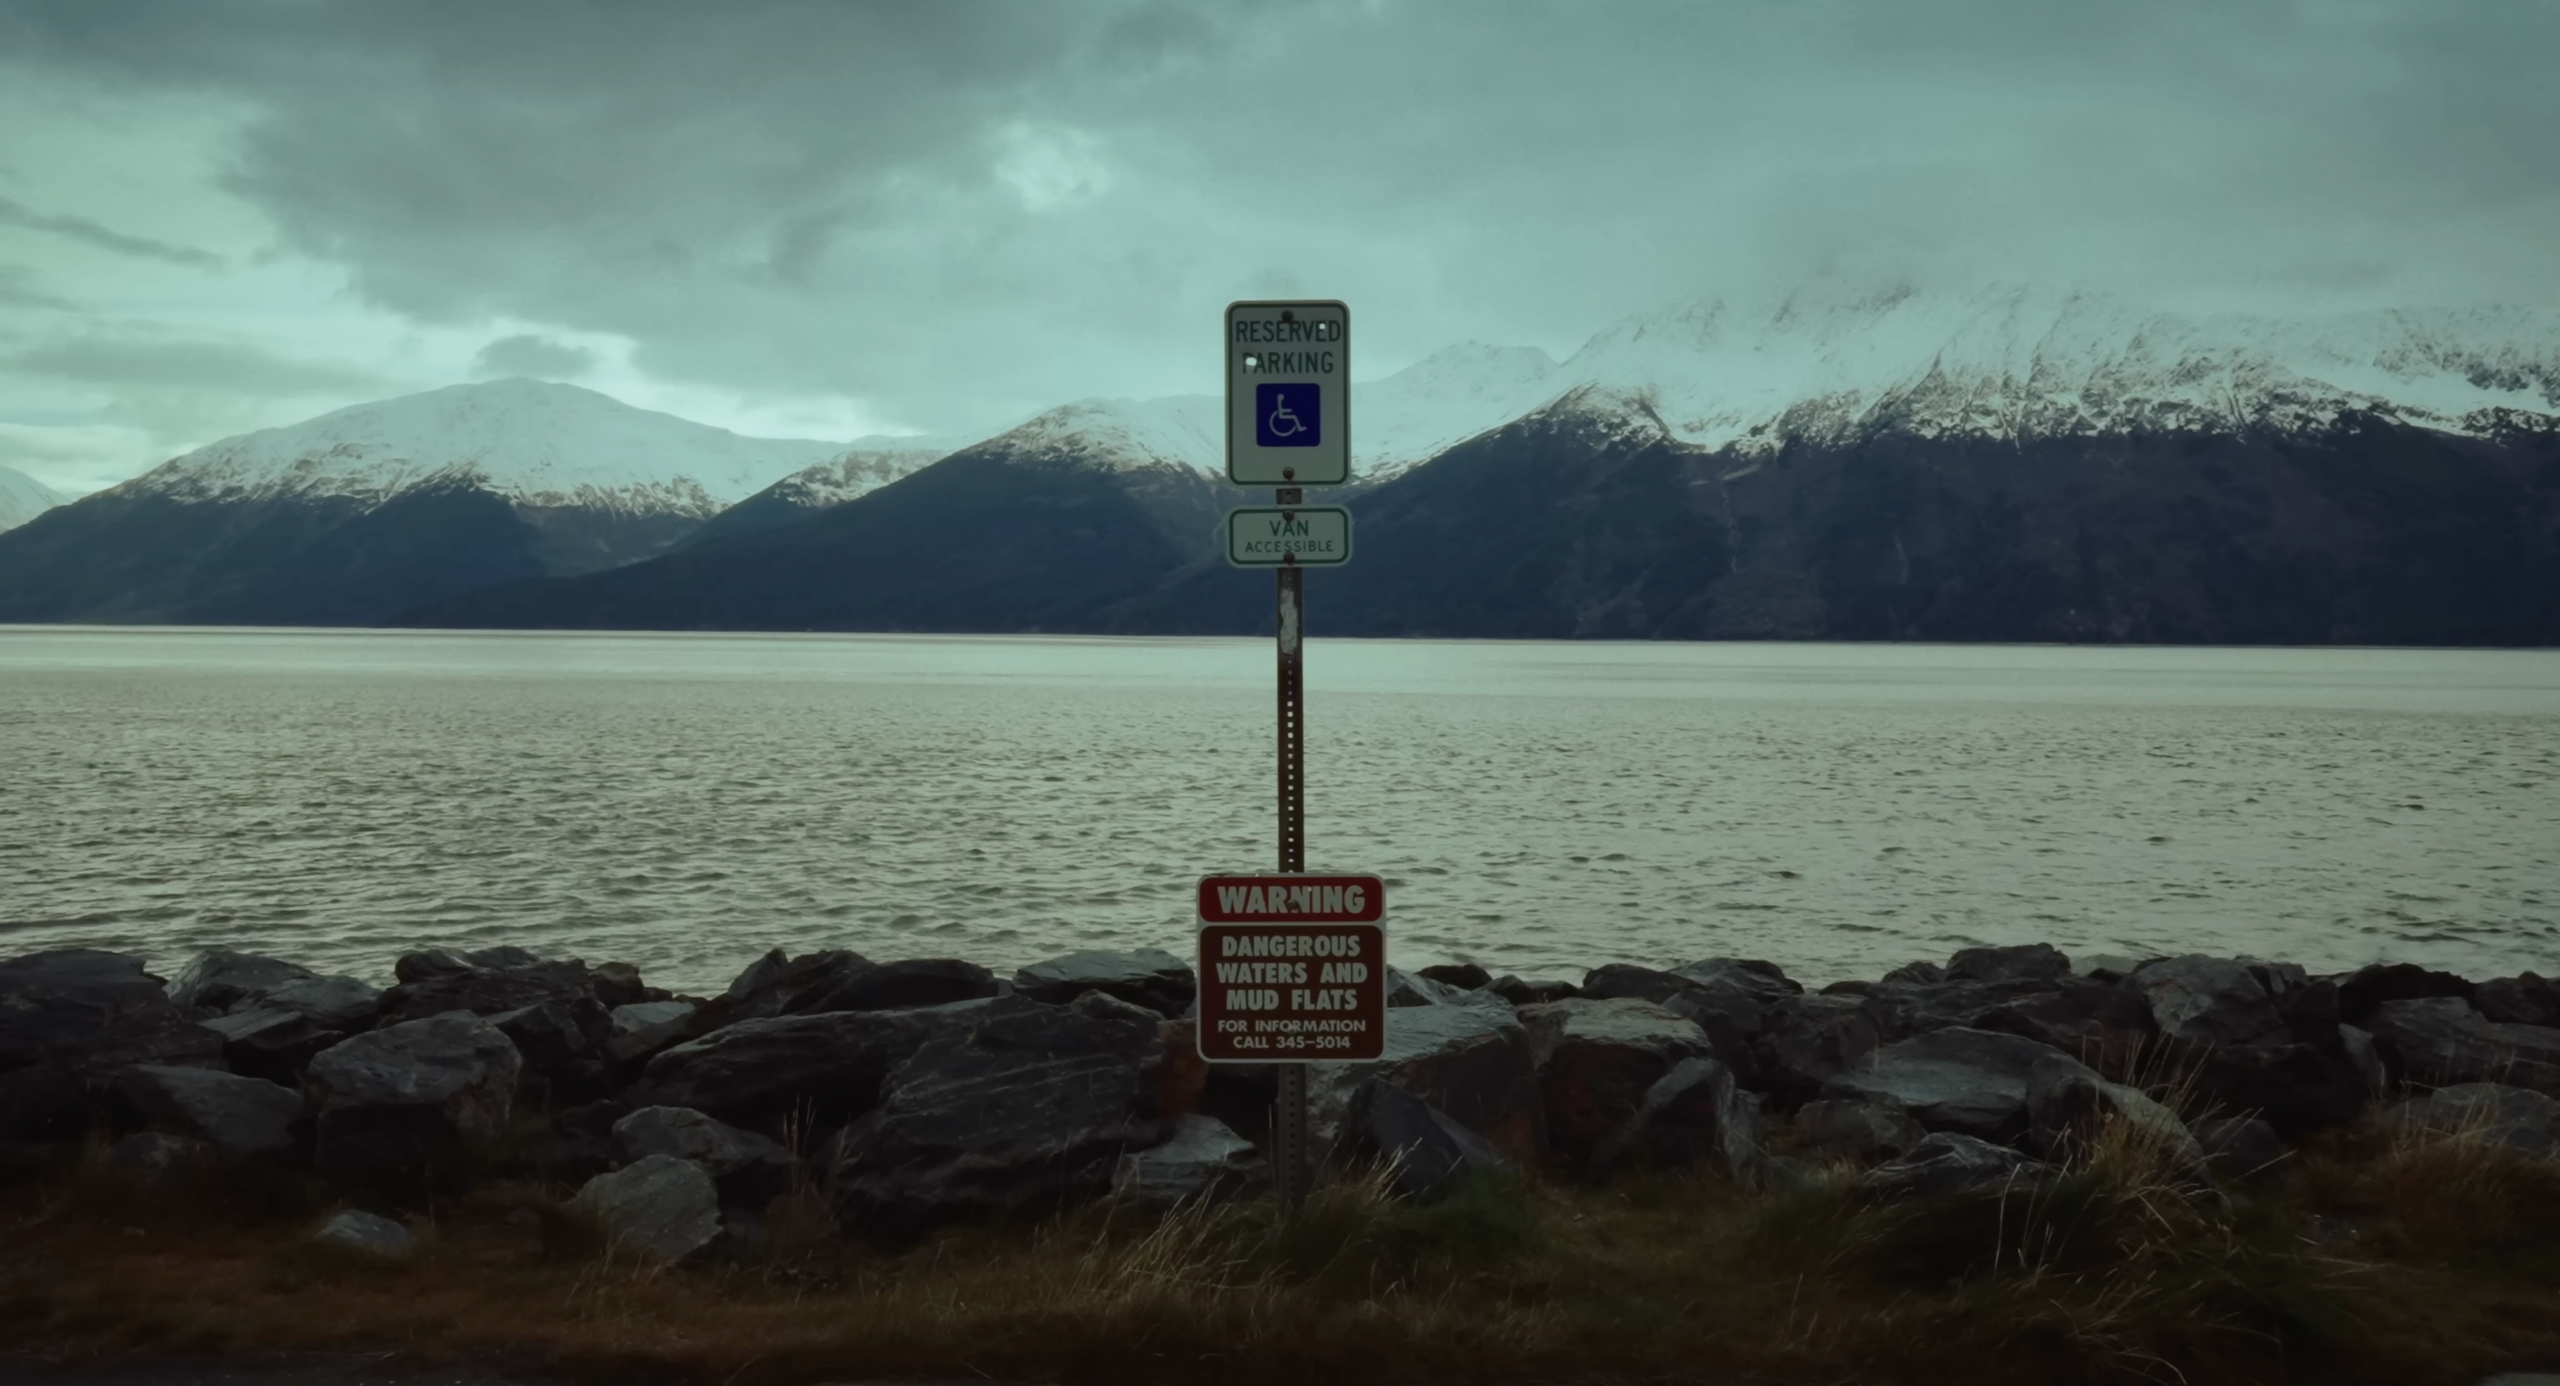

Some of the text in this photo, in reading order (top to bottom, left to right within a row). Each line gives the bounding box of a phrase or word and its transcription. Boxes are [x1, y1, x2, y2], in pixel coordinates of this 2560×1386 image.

[1235, 320, 1341, 343] RESERVED
[1242, 351, 1334, 374] PARKING
[1269, 520, 1309, 537] VAN
[1245, 540, 1334, 553] ACCESSIBLE
[1217, 885, 1366, 914] WARNING
[1222, 935, 1360, 957] DANGEROUS
[1216, 962, 1368, 984] WATERS AND
[1226, 989, 1358, 1011] MUD FLATS
[1217, 1020, 1366, 1032] FOR INFORMATION
[1233, 1036, 1350, 1049] CALL 345-5014
